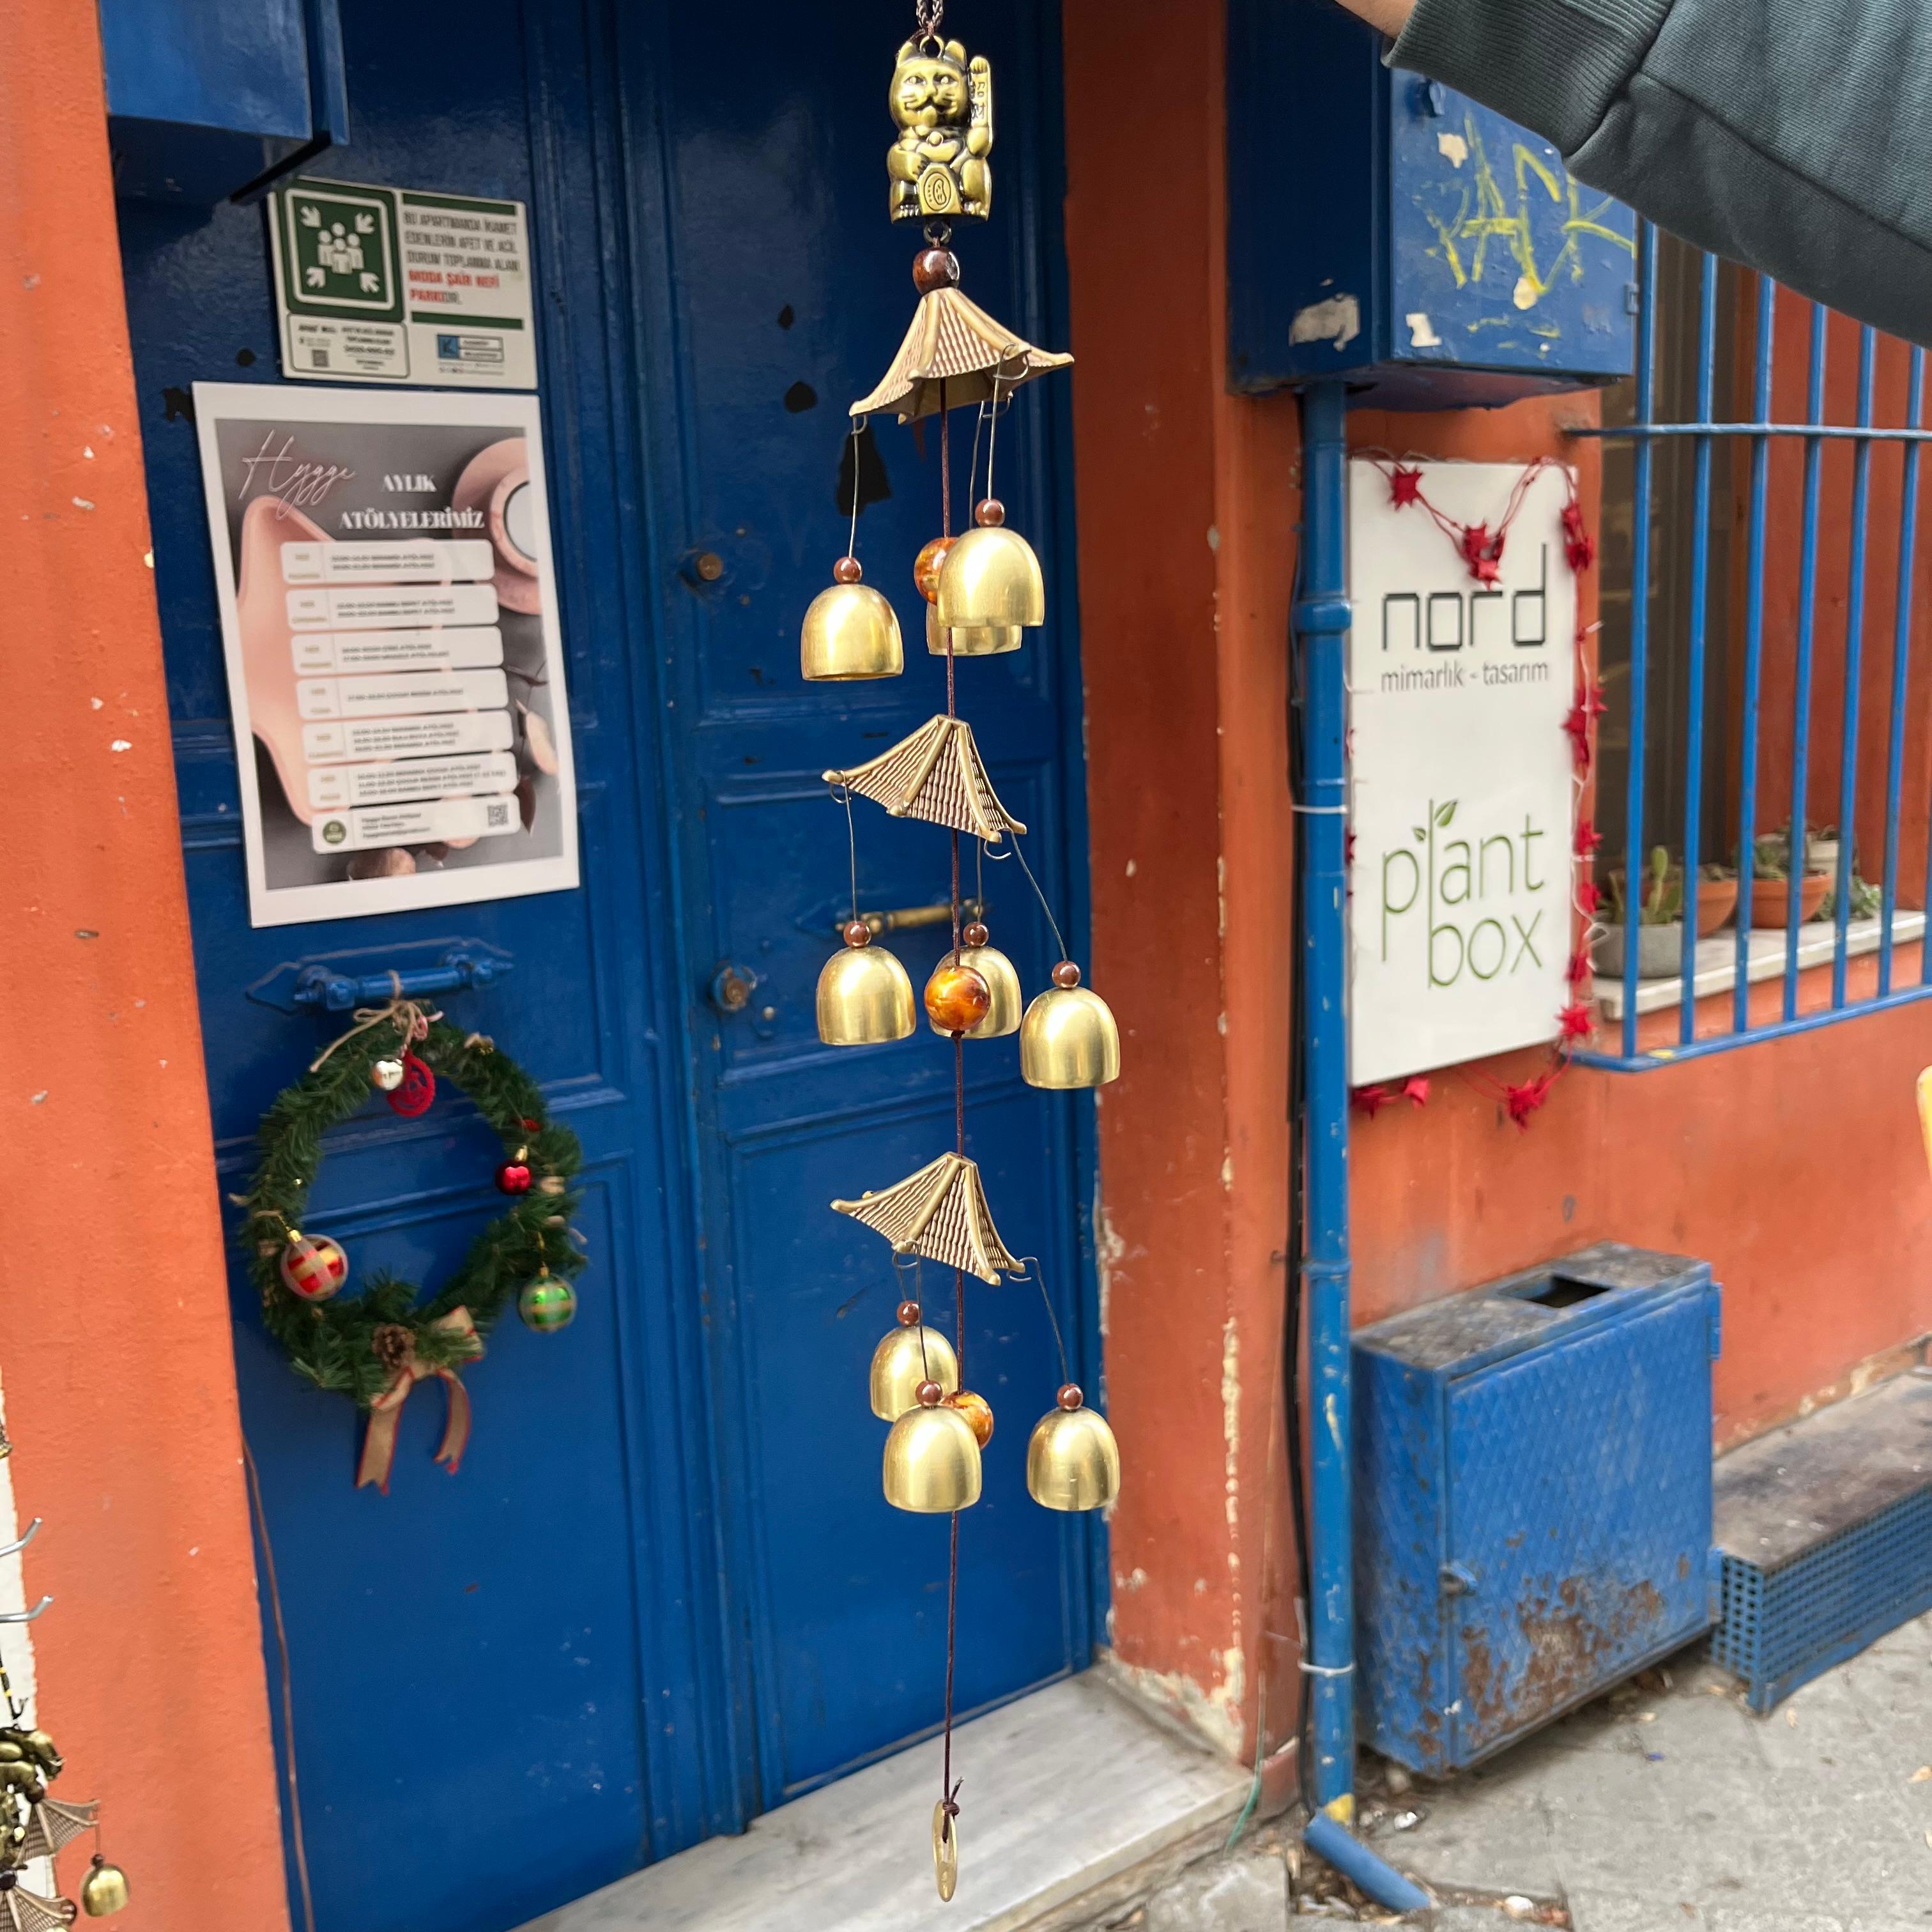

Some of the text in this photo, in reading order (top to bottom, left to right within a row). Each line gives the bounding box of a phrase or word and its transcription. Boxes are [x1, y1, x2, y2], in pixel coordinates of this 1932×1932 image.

[238, 429, 357, 520] Hygge
[382, 473, 437, 493] AYLIK
[339, 507, 485, 530] ATÖLYELERİMİZ
[1382, 544, 1547, 651] nord
[1381, 660, 1464, 693] mimarlık
[1482, 661, 1549, 686] tasarım
[1381, 799, 1545, 962] plant
[1427, 908, 1543, 989] box
